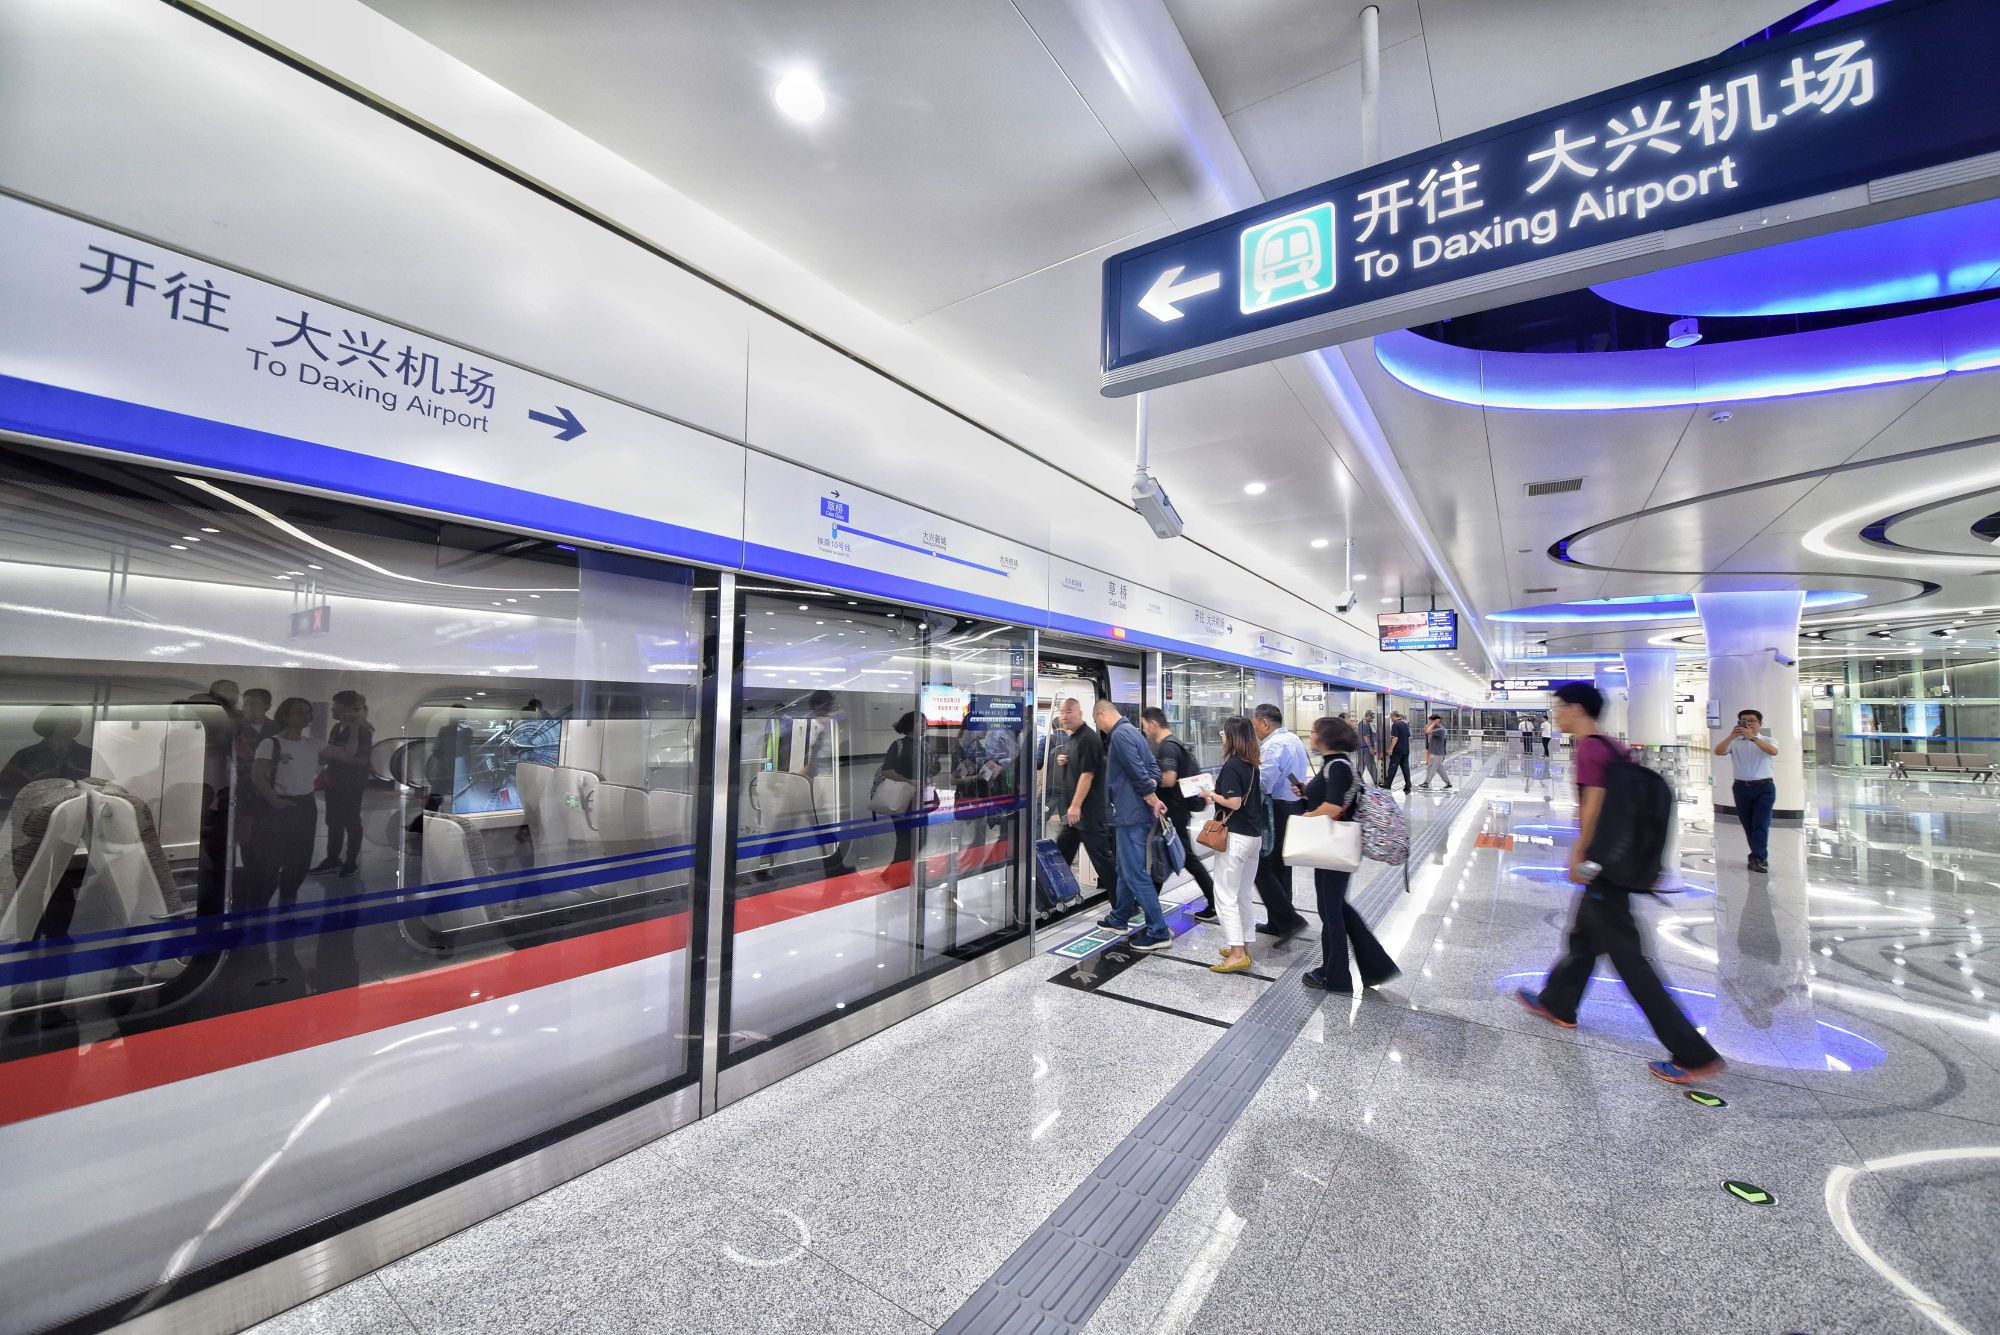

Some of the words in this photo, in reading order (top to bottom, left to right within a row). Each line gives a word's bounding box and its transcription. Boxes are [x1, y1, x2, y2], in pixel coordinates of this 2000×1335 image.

[1353, 160, 1484, 242] 开往
[1526, 39, 1874, 194] 大兴机场
[1354, 250, 1399, 282] To
[1413, 209, 1557, 269] Daxing
[1569, 156, 1738, 228] Airport
[80, 244, 231, 332] 开往
[271, 311, 496, 409] 大兴机场
[246, 347, 287, 376] To
[299, 363, 397, 411] Daxing
[406, 395, 488, 433] Airport
